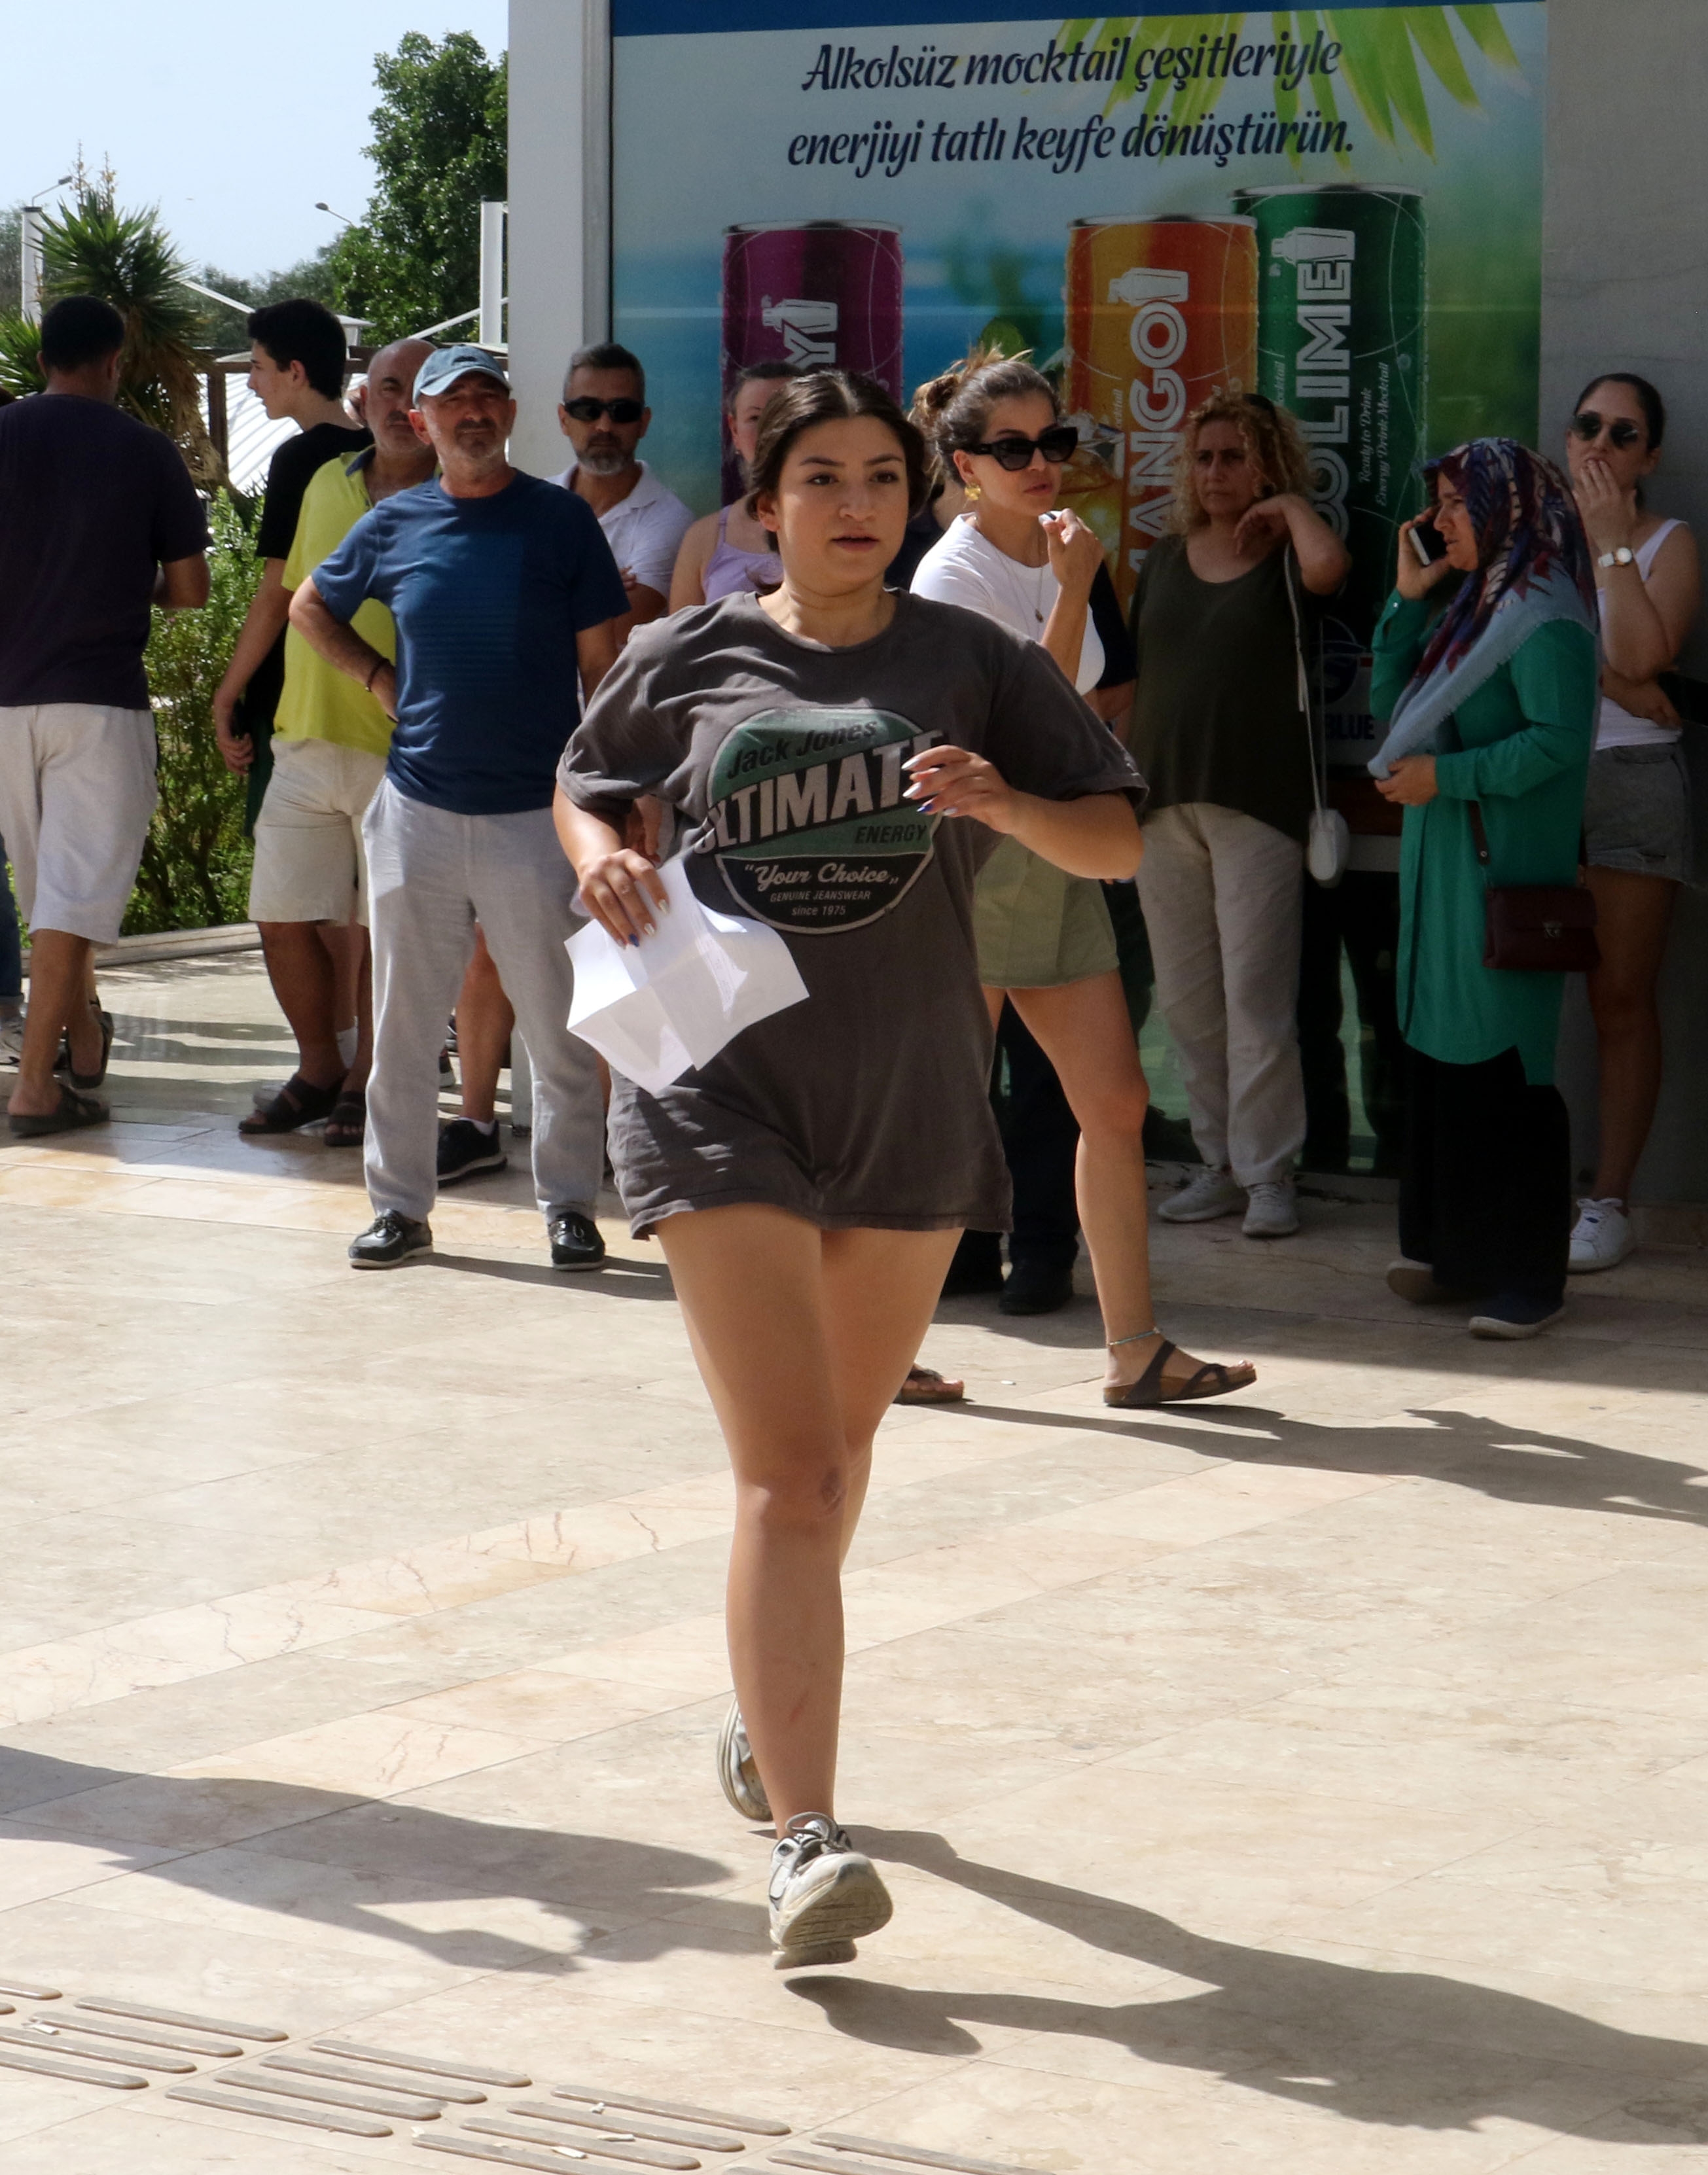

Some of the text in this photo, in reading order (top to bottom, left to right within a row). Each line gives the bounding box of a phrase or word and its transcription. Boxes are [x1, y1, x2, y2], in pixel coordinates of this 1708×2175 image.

[801, 30, 1342, 92] Alkolsüz mocktail çeşitleriyle
[788, 110, 1353, 178] enerjiyi tatlı keyfe dönüştürün.
[1129, 300, 1188, 575] ANGO
[1357, 387, 1374, 483] Ready to Drink
[1375, 361, 1391, 506] Energy Drink Mocktail
[727, 721, 878, 779] Jack Jones
[694, 730, 944, 853] LTIMAT
[855, 824, 927, 843] ENERGY
[770, 891, 872, 902] GENUINE JEANSWEAR
[792, 905, 846, 916] since 1975
